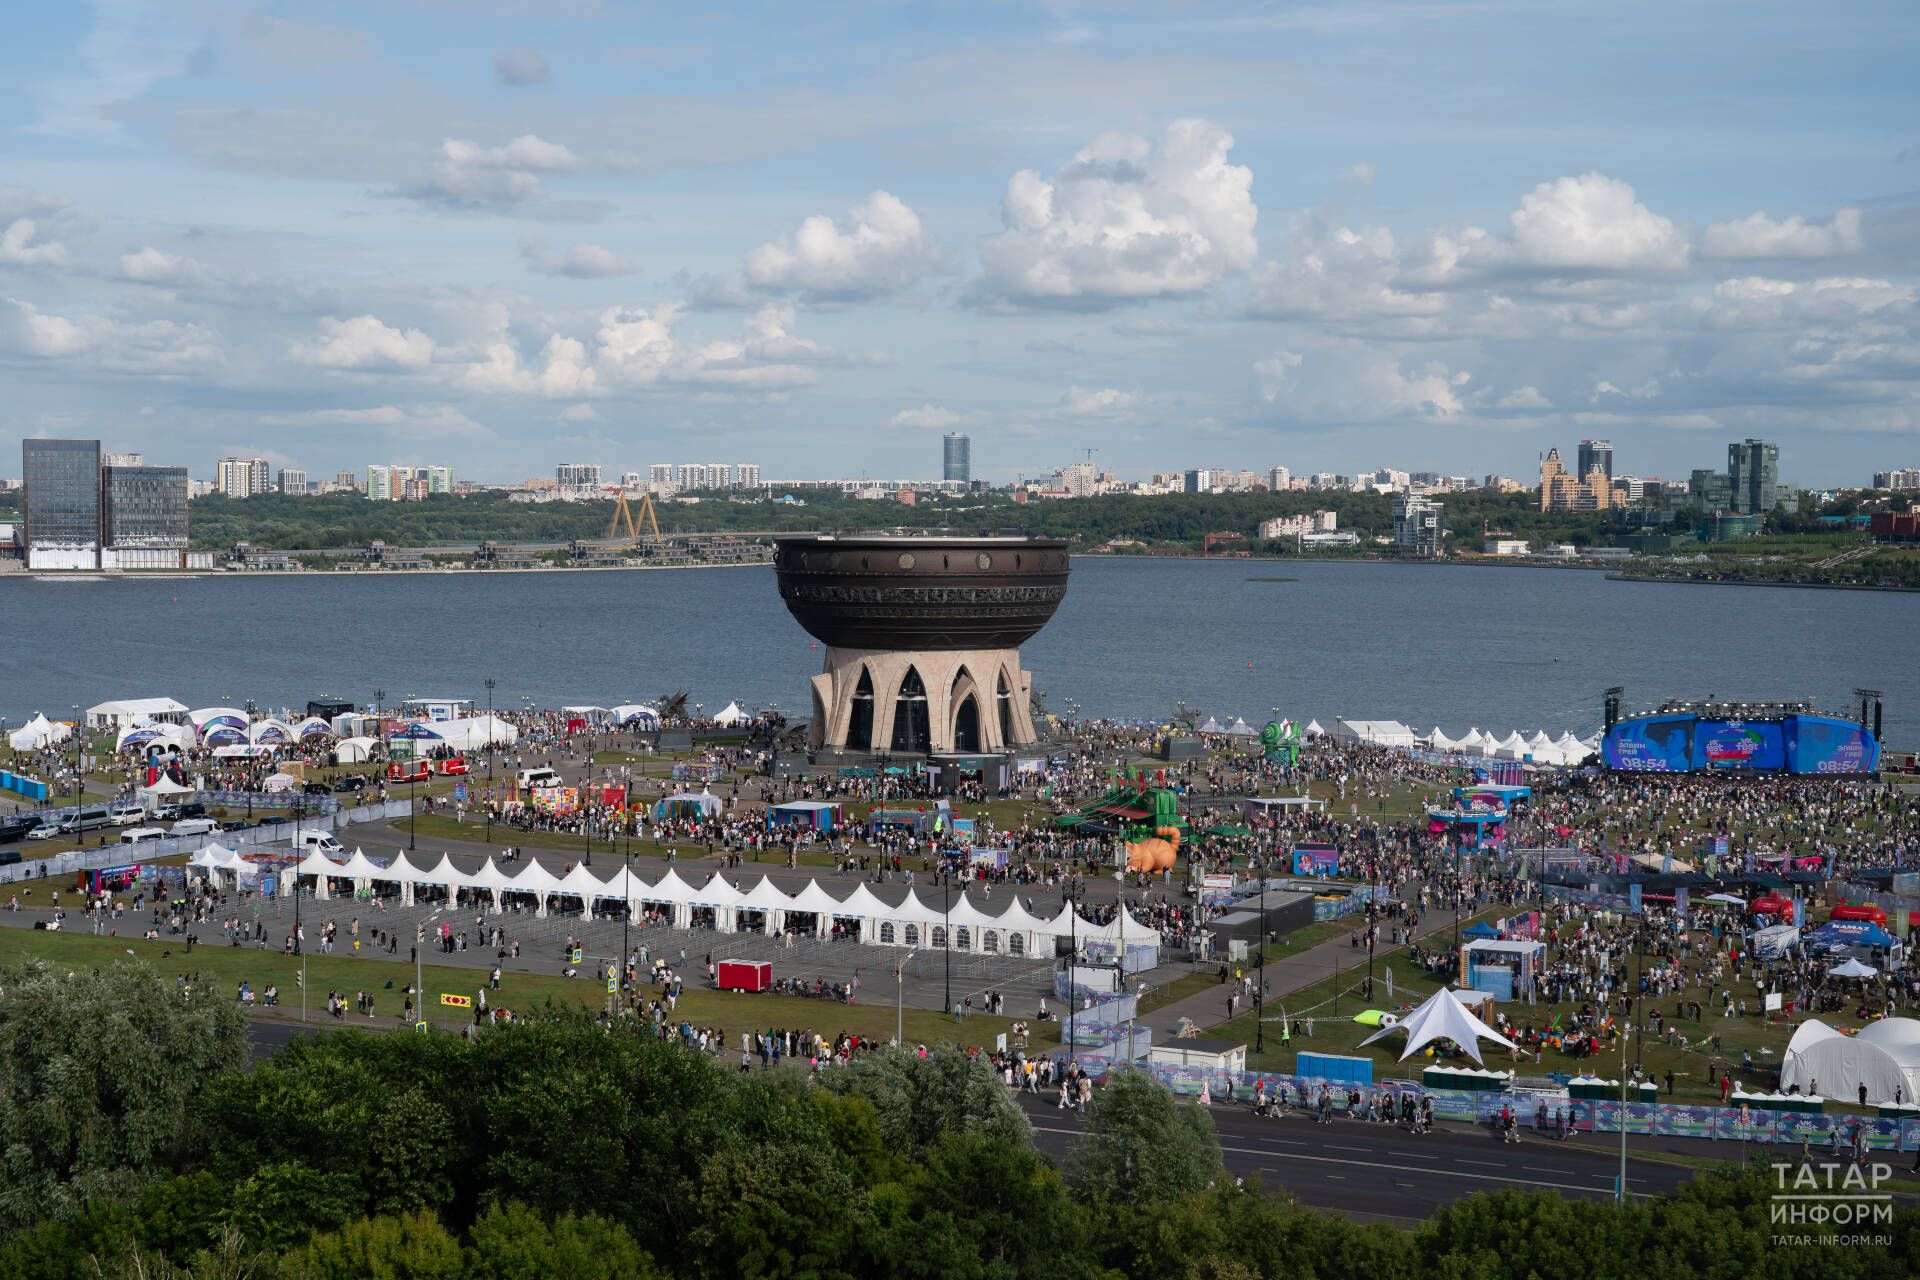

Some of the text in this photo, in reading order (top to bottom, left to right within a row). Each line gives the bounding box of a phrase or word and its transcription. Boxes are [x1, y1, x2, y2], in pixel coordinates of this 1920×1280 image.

[1622, 757, 1667, 768] 08:54
[1817, 760, 1859, 771] 08:54
[1832, 923, 1870, 931] KAMAZ
